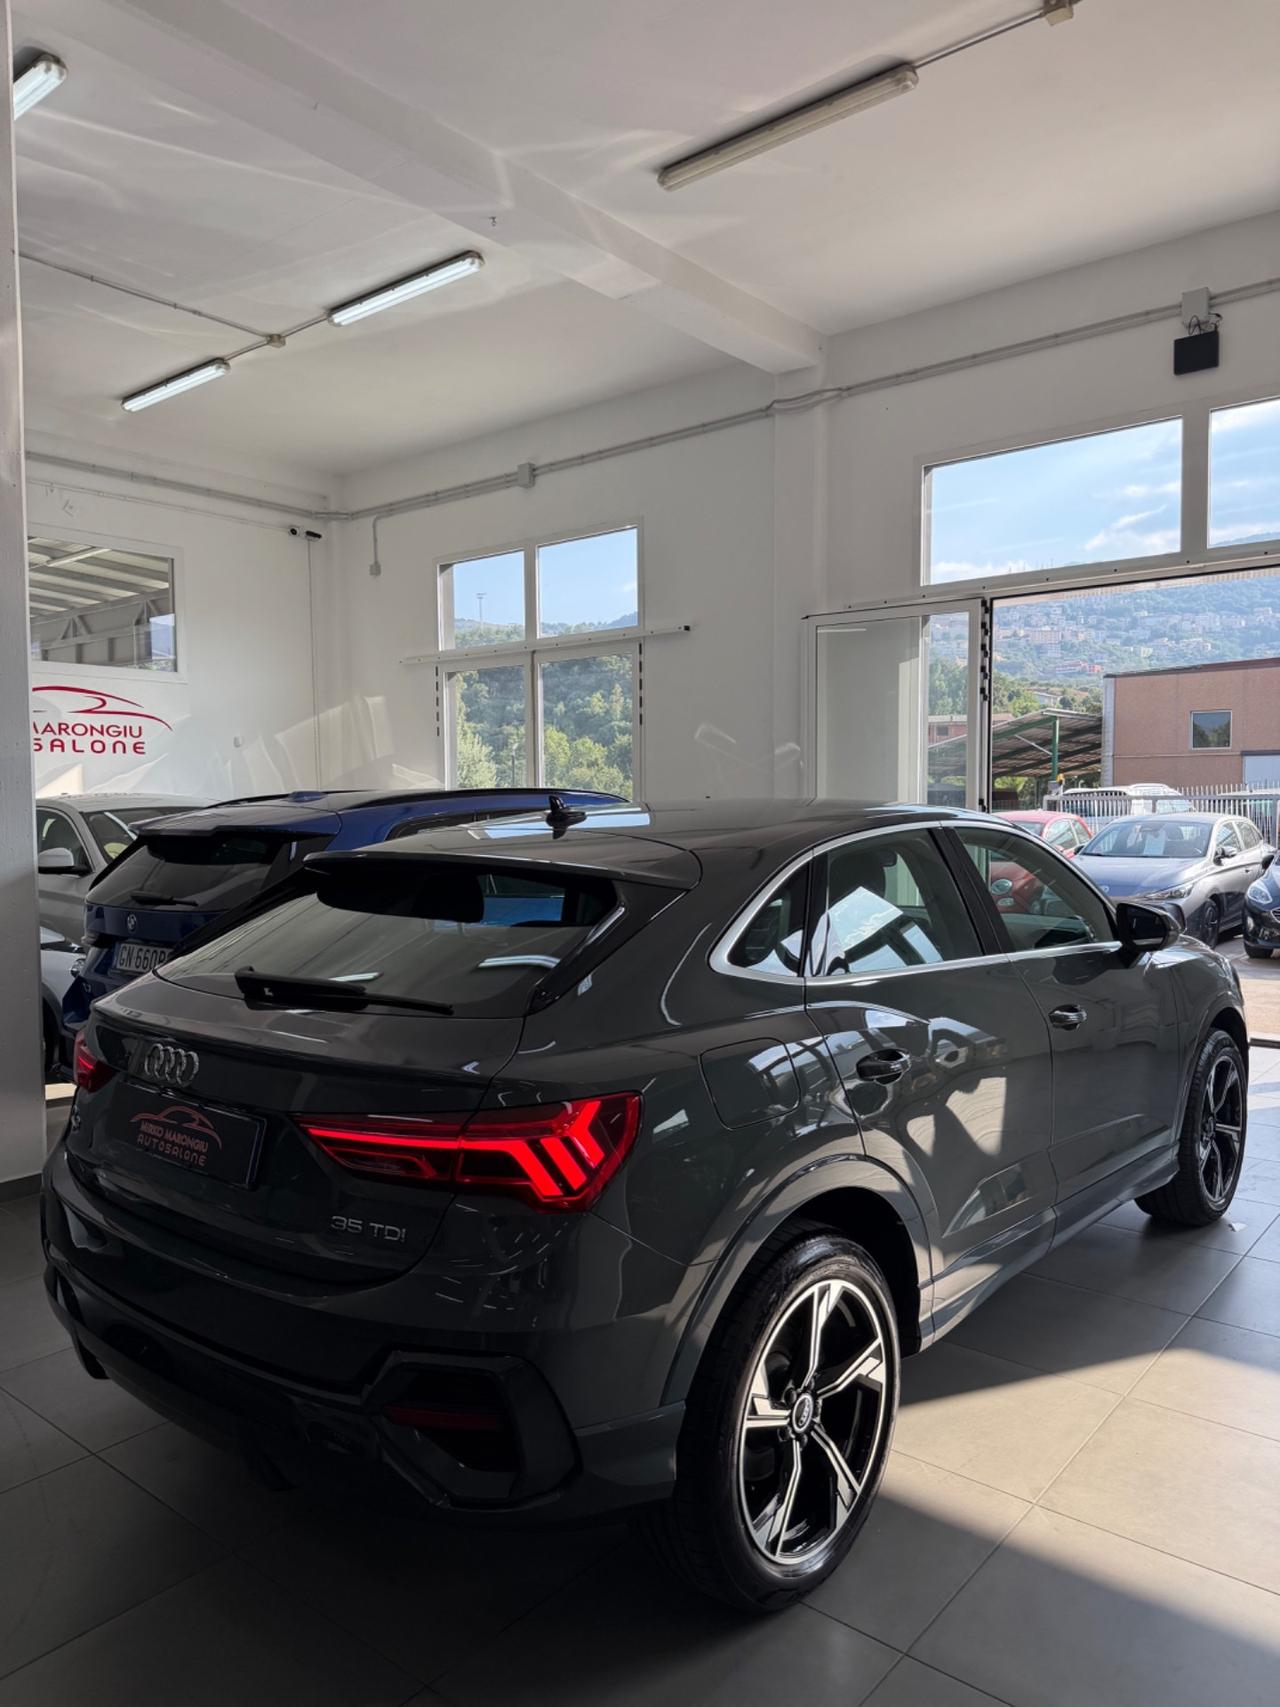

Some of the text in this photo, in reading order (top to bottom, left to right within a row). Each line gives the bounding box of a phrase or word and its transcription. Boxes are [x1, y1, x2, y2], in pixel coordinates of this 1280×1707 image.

[119, 945, 135, 968] GN
[330, 1215, 406, 1242] 35 TDI
